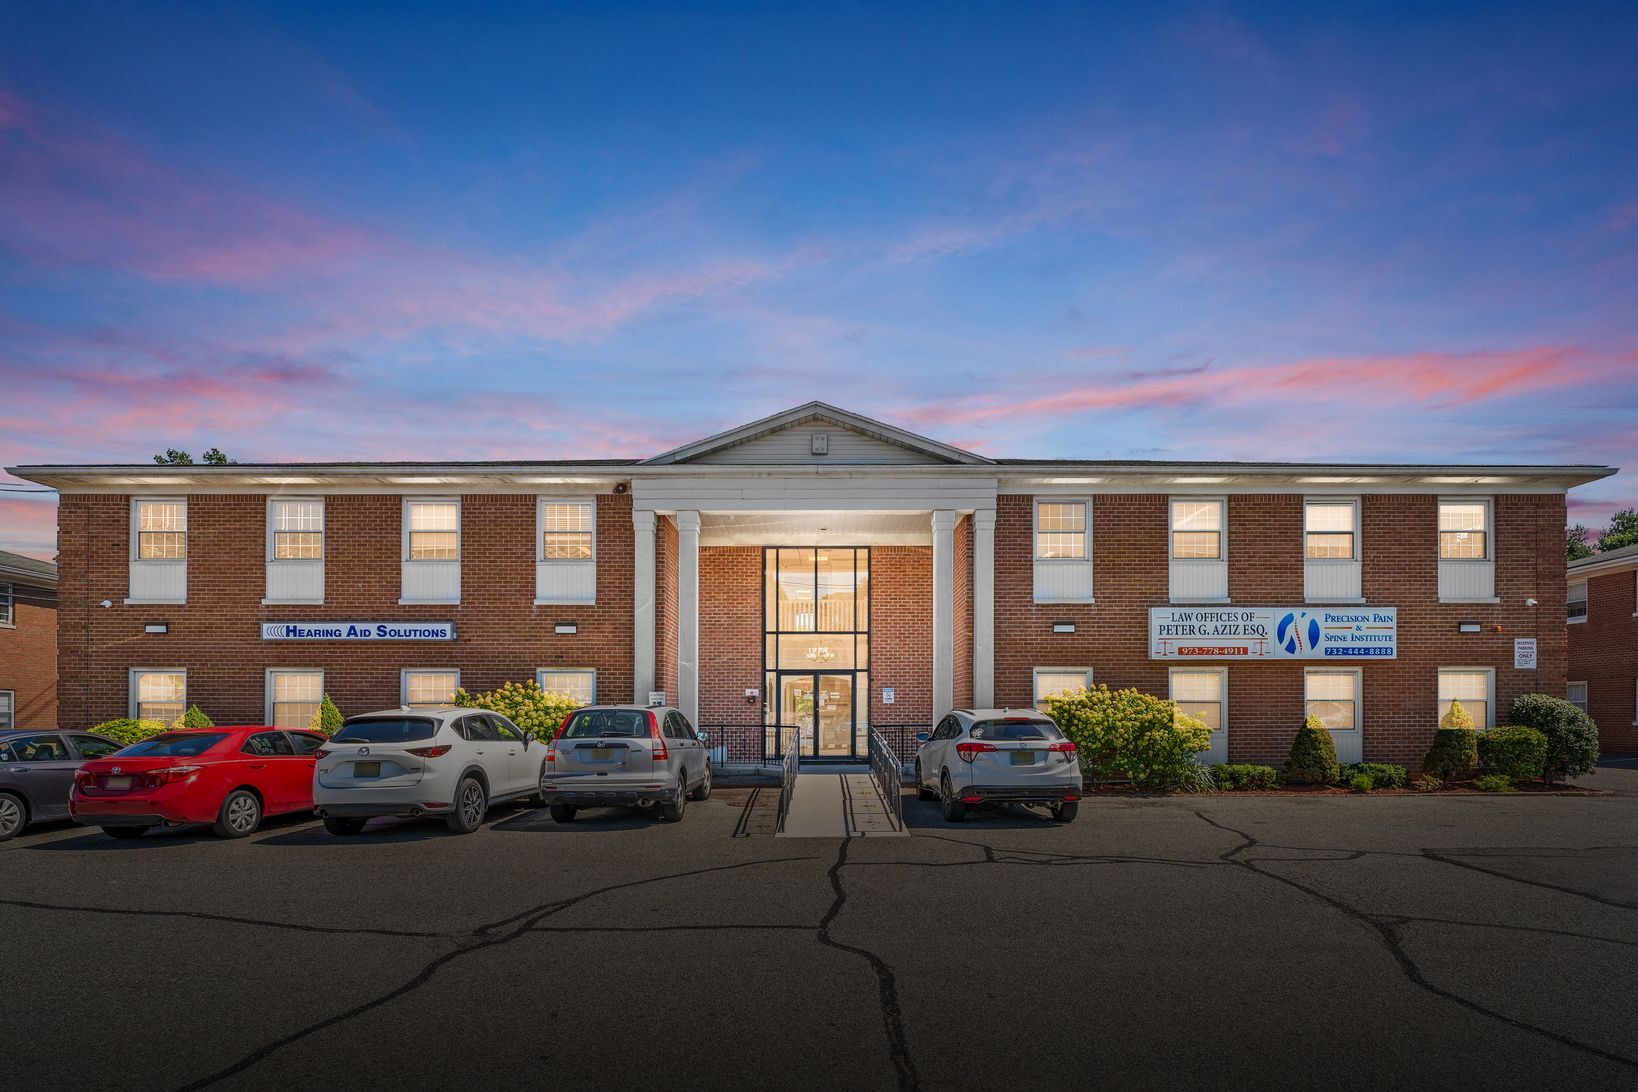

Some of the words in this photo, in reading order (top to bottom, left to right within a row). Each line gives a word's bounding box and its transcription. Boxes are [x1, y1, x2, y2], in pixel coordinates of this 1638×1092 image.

[1171, 612, 1194, 622] LAW
[1195, 612, 1239, 622] OFFICES
[1241, 612, 1256, 622] OF
[1324, 613, 1370, 623] PRECISION
[1373, 613, 1393, 623] PAIN
[285, 624, 342, 638] HEARING
[346, 624, 372, 638] AID
[376, 624, 447, 638] SOLUTIONS
[1158, 624, 1196, 636] PETER
[1198, 624, 1210, 636] G.
[1212, 624, 1241, 636] AZIZ
[1243, 624, 1268, 637] ESQ.
[1324, 633, 1348, 642] SPINE
[1350, 633, 1394, 642] INSTITUTE
[1182, 647, 1244, 655] 973-778-4911
